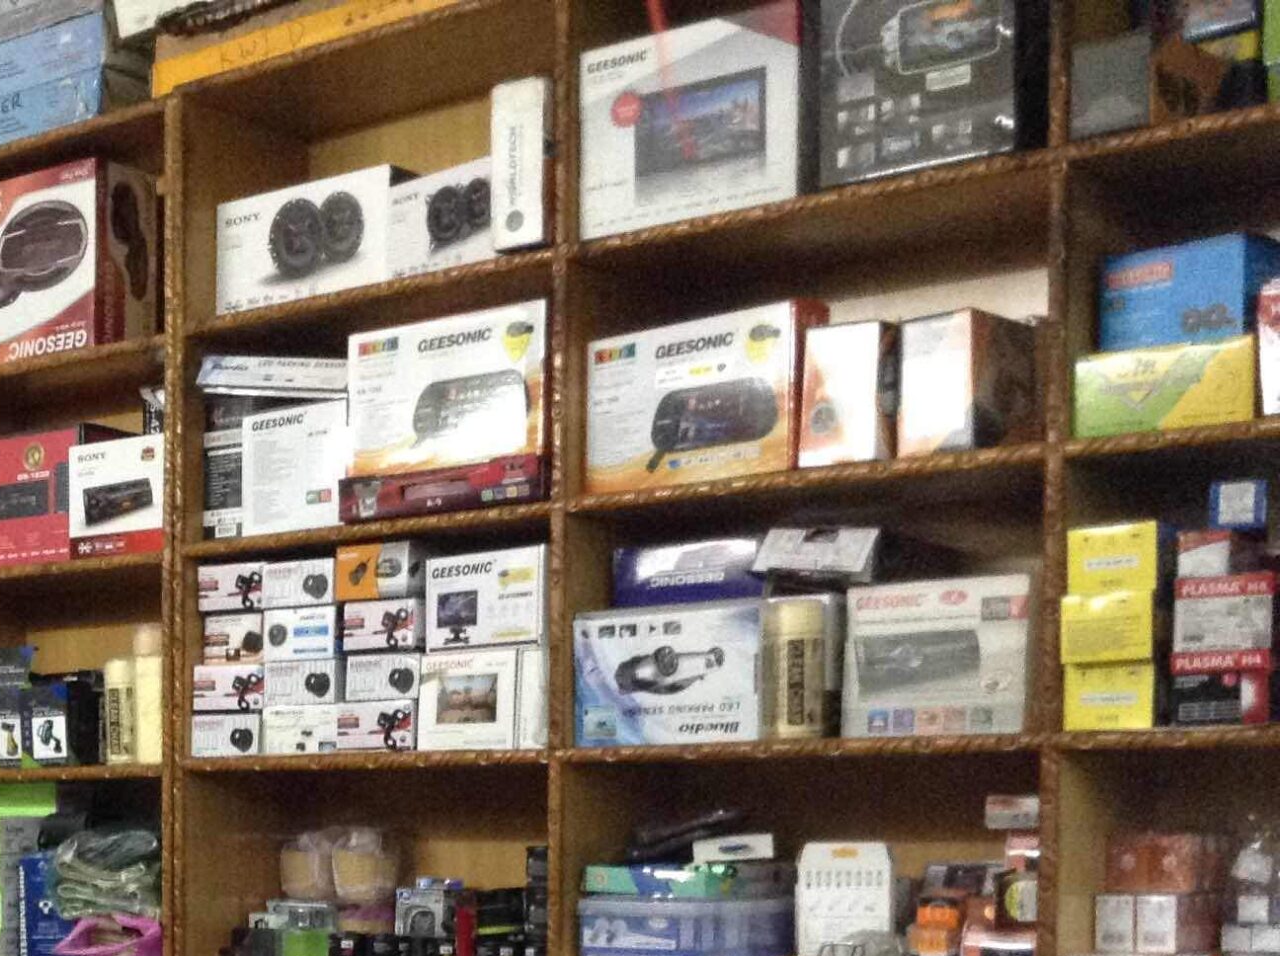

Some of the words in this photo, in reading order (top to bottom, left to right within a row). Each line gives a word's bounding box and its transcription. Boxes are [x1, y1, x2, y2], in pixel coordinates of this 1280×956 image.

[587, 50, 647, 74] GEESONIC
[225, 211, 261, 228] SONY
[8, 329, 88, 361] GEESONIC
[418, 327, 493, 353] GEESONIC
[654, 332, 735, 360] GEESONIC
[252, 413, 304, 432] GEESONIC
[77, 451, 107, 463] SONY
[432, 561, 493, 579] GEESONIC
[650, 572, 725, 589] GEESONIC
[1181, 582, 1240, 596] PLASMA
[1175, 656, 1234, 670] PLASMA
[668, 703, 714, 713] PARKING
